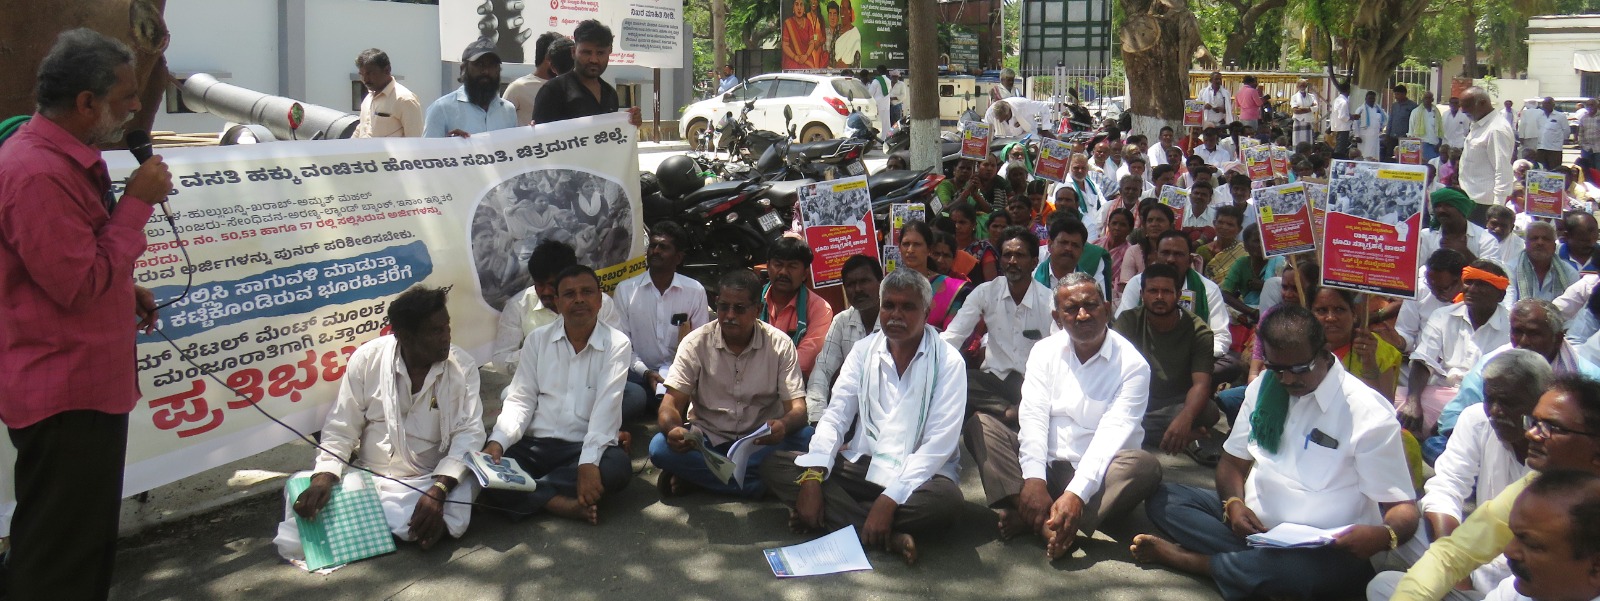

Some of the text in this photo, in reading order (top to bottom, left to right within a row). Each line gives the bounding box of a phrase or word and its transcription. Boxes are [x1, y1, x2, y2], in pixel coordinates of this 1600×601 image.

[180, 169, 241, 188] ವಸತಿ
[246, 165, 302, 185] ಹಕ್ಕು
[300, 159, 378, 178] ವಂಚಿತರ
[382, 155, 459, 172] ಹೋರಾಟ
[461, 149, 514, 167] ಸಮಿತಿ,
[516, 135, 588, 159] ಚಿತ್ರದುರ್ಗ
[594, 127, 629, 146] ಜಿಲ್ಲೆ.
[142, 203, 359, 238] ಲು-ಬಂಜರು-ಸೇಂಧಿವನ-ಅರಣ್ಯ-ಲ್ಯಾಂಡ್
[397, 197, 423, 208] ಇನಾಂ
[338, 191, 373, 203] ಮಹಲ್
[193, 234, 218, 246] ನಂ.
[221, 229, 257, 241] 50,53
[260, 224, 297, 237] ಹಾಗೂ
[300, 222, 313, 231] 57
[317, 218, 337, 231] ರಲ್ಲಿ
[337, 211, 386, 227] ಸಲ್ಲಿಸಿರುವ
[388, 205, 441, 219] ಅರ್ಜಿಗಳನ್ನು
[132, 229, 416, 284] ರುವ ಅರ್ಜಿಗಳನ್ನು ಪುನರ್ ಪರಿಶೀಲಿಸಬೇಕು.
[171, 283, 228, 309] ಸಲ್ಲಿಸಿ
[236, 266, 318, 296] ಸಾಗುವಳಿ
[171, 284, 313, 328] ಕಟ್ಟಿಕೊಂಡಿರುವ
[180, 331, 249, 362] ಸೆಟಲ್
[256, 316, 318, 344] ಮೆಂಟ್
[322, 300, 386, 328] ಮೂಲಕ
[148, 332, 394, 438] ಪ್ರತಿಭಟ
[153, 335, 315, 388] ಮಂಜೂರಾತಿಗಾಗಿ
